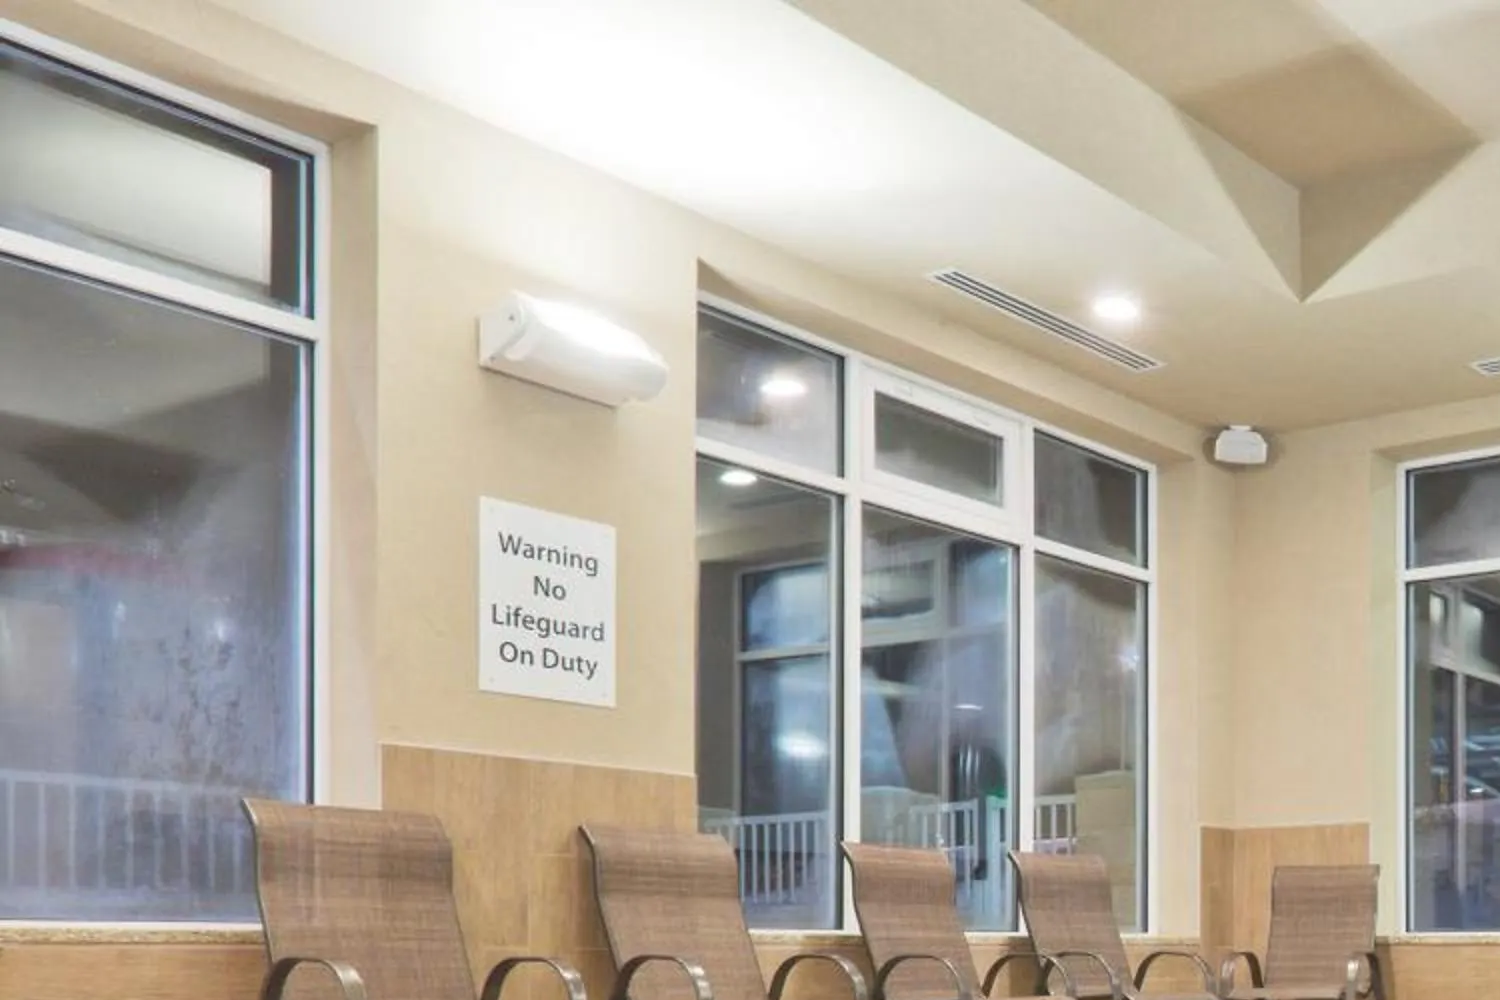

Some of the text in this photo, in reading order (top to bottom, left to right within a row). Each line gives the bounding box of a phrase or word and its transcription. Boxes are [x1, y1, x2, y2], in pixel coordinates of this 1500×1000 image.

[498, 531, 598, 577] Warning
[533, 575, 567, 601] No
[491, 603, 605, 642] Lifeguard
[499, 641, 598, 680] On Duty
